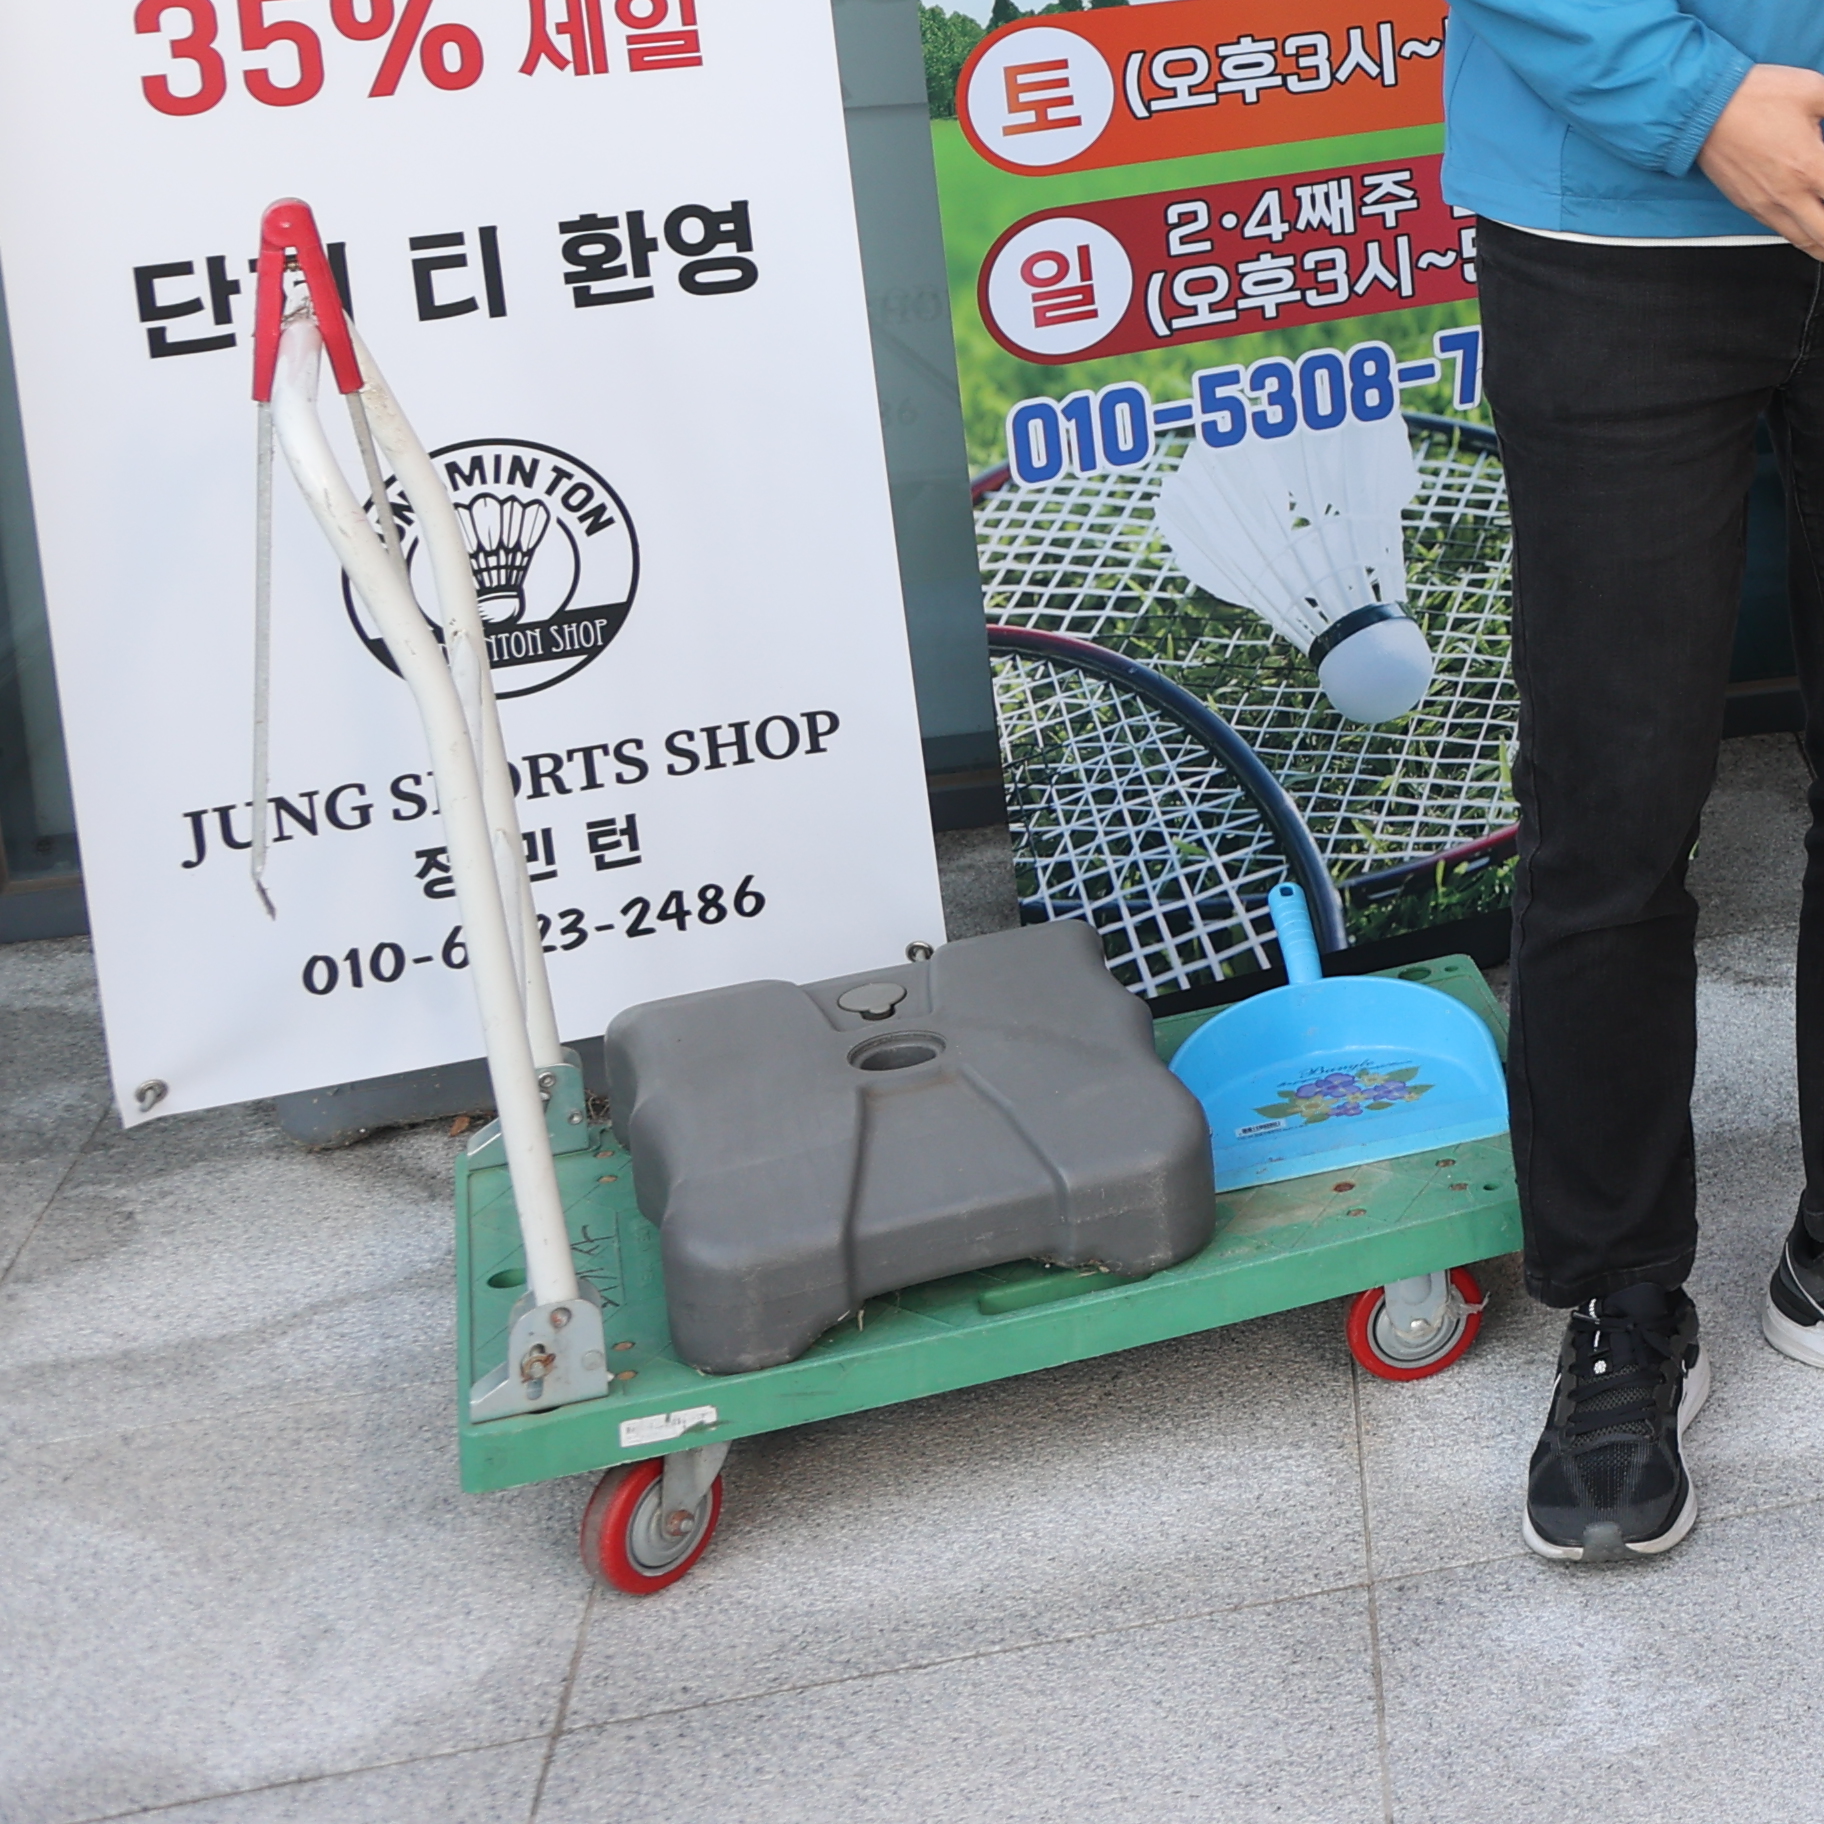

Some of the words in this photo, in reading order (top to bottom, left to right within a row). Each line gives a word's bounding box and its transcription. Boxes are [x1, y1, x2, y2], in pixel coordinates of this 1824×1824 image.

[1000, 57, 1083, 138] 토
[408, 224, 508, 323] 티
[557, 198, 760, 310] 환영
[1019, 242, 1100, 330] 일
[551, 618, 608, 653] SHOP
[181, 782, 374, 869] JUNG
[390, 737, 650, 822] SRTS
[664, 709, 841, 777] SHOP
[301, 874, 766, 996] 010-623-2486
